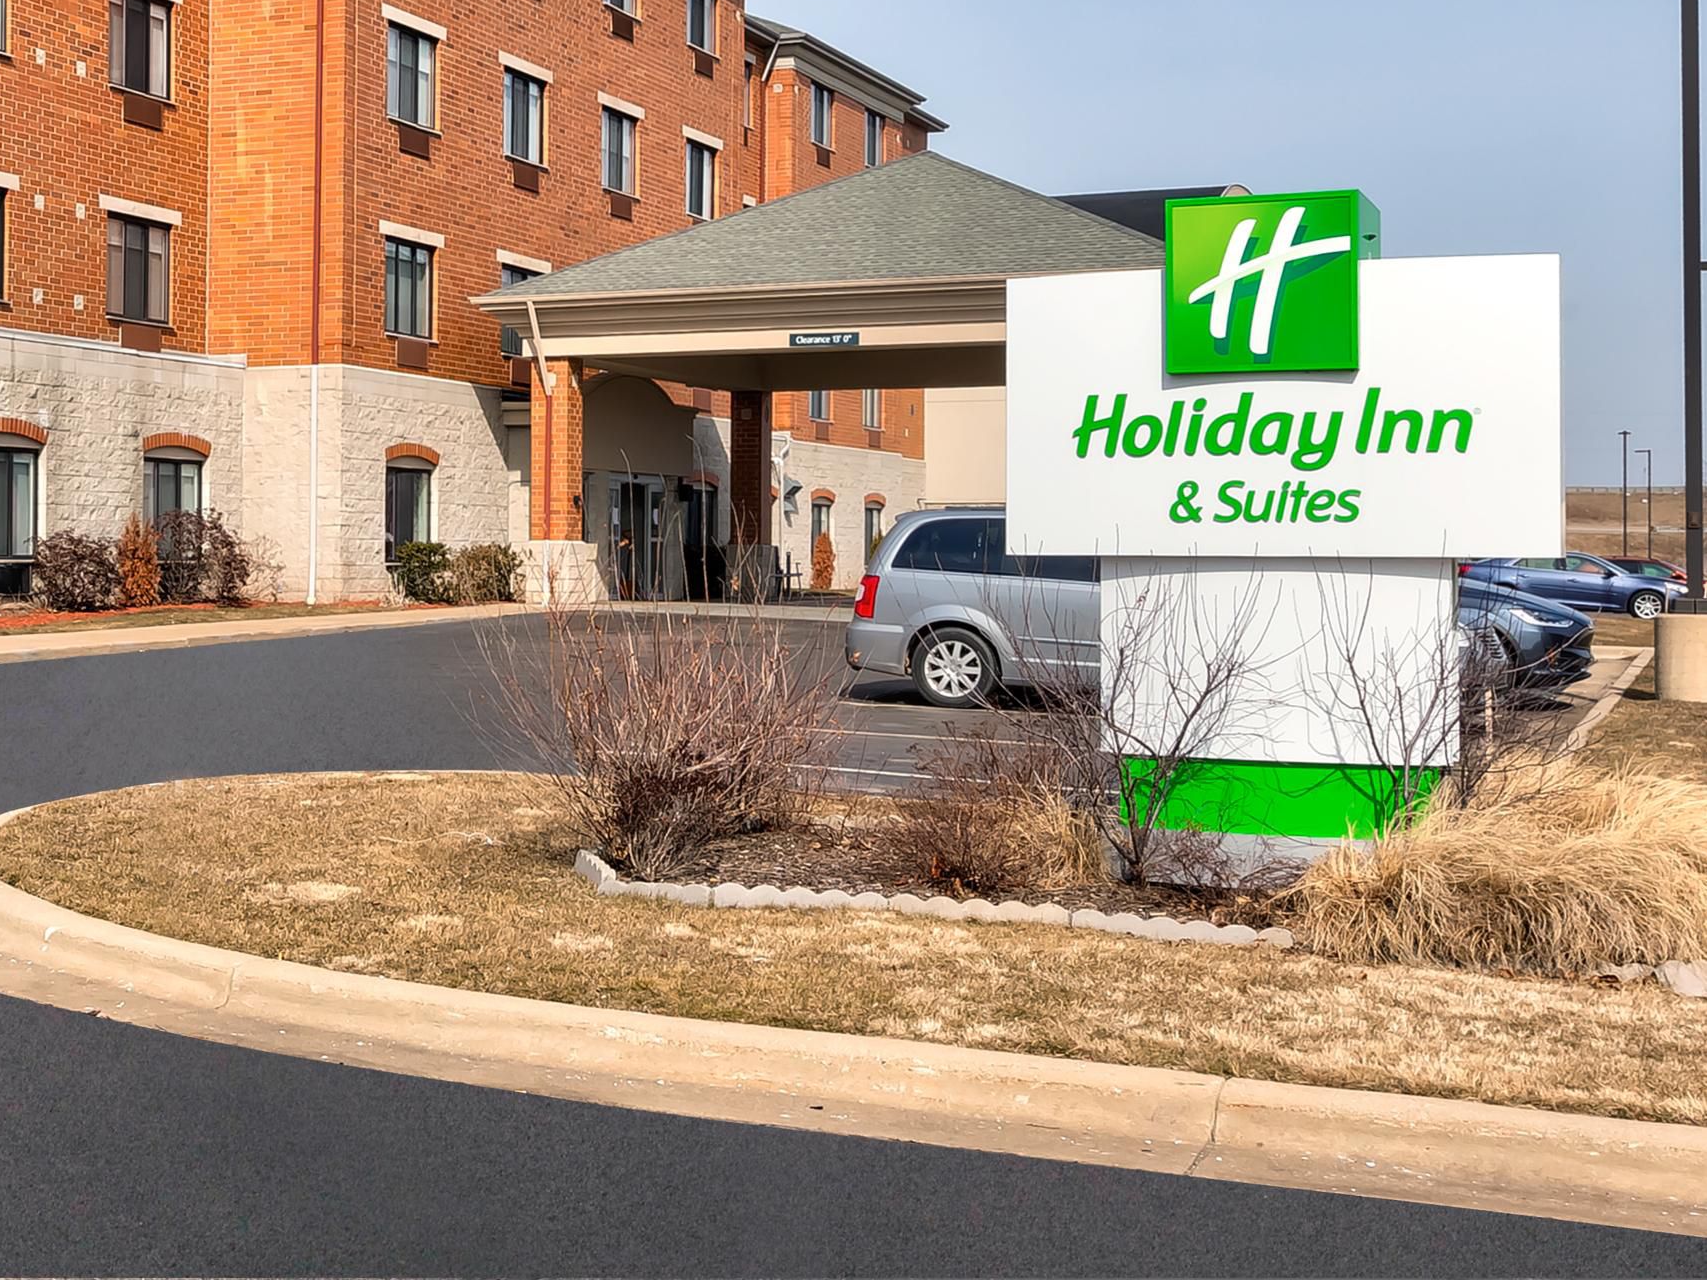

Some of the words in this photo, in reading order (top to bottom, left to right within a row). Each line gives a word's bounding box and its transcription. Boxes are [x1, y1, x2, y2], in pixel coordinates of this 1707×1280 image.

[795, 335, 831, 345] Clearance
[1072, 391, 1344, 472] Holiday
[1355, 386, 1474, 454] Inn
[1169, 480, 1202, 524] &
[1213, 479, 1362, 524] Suites
